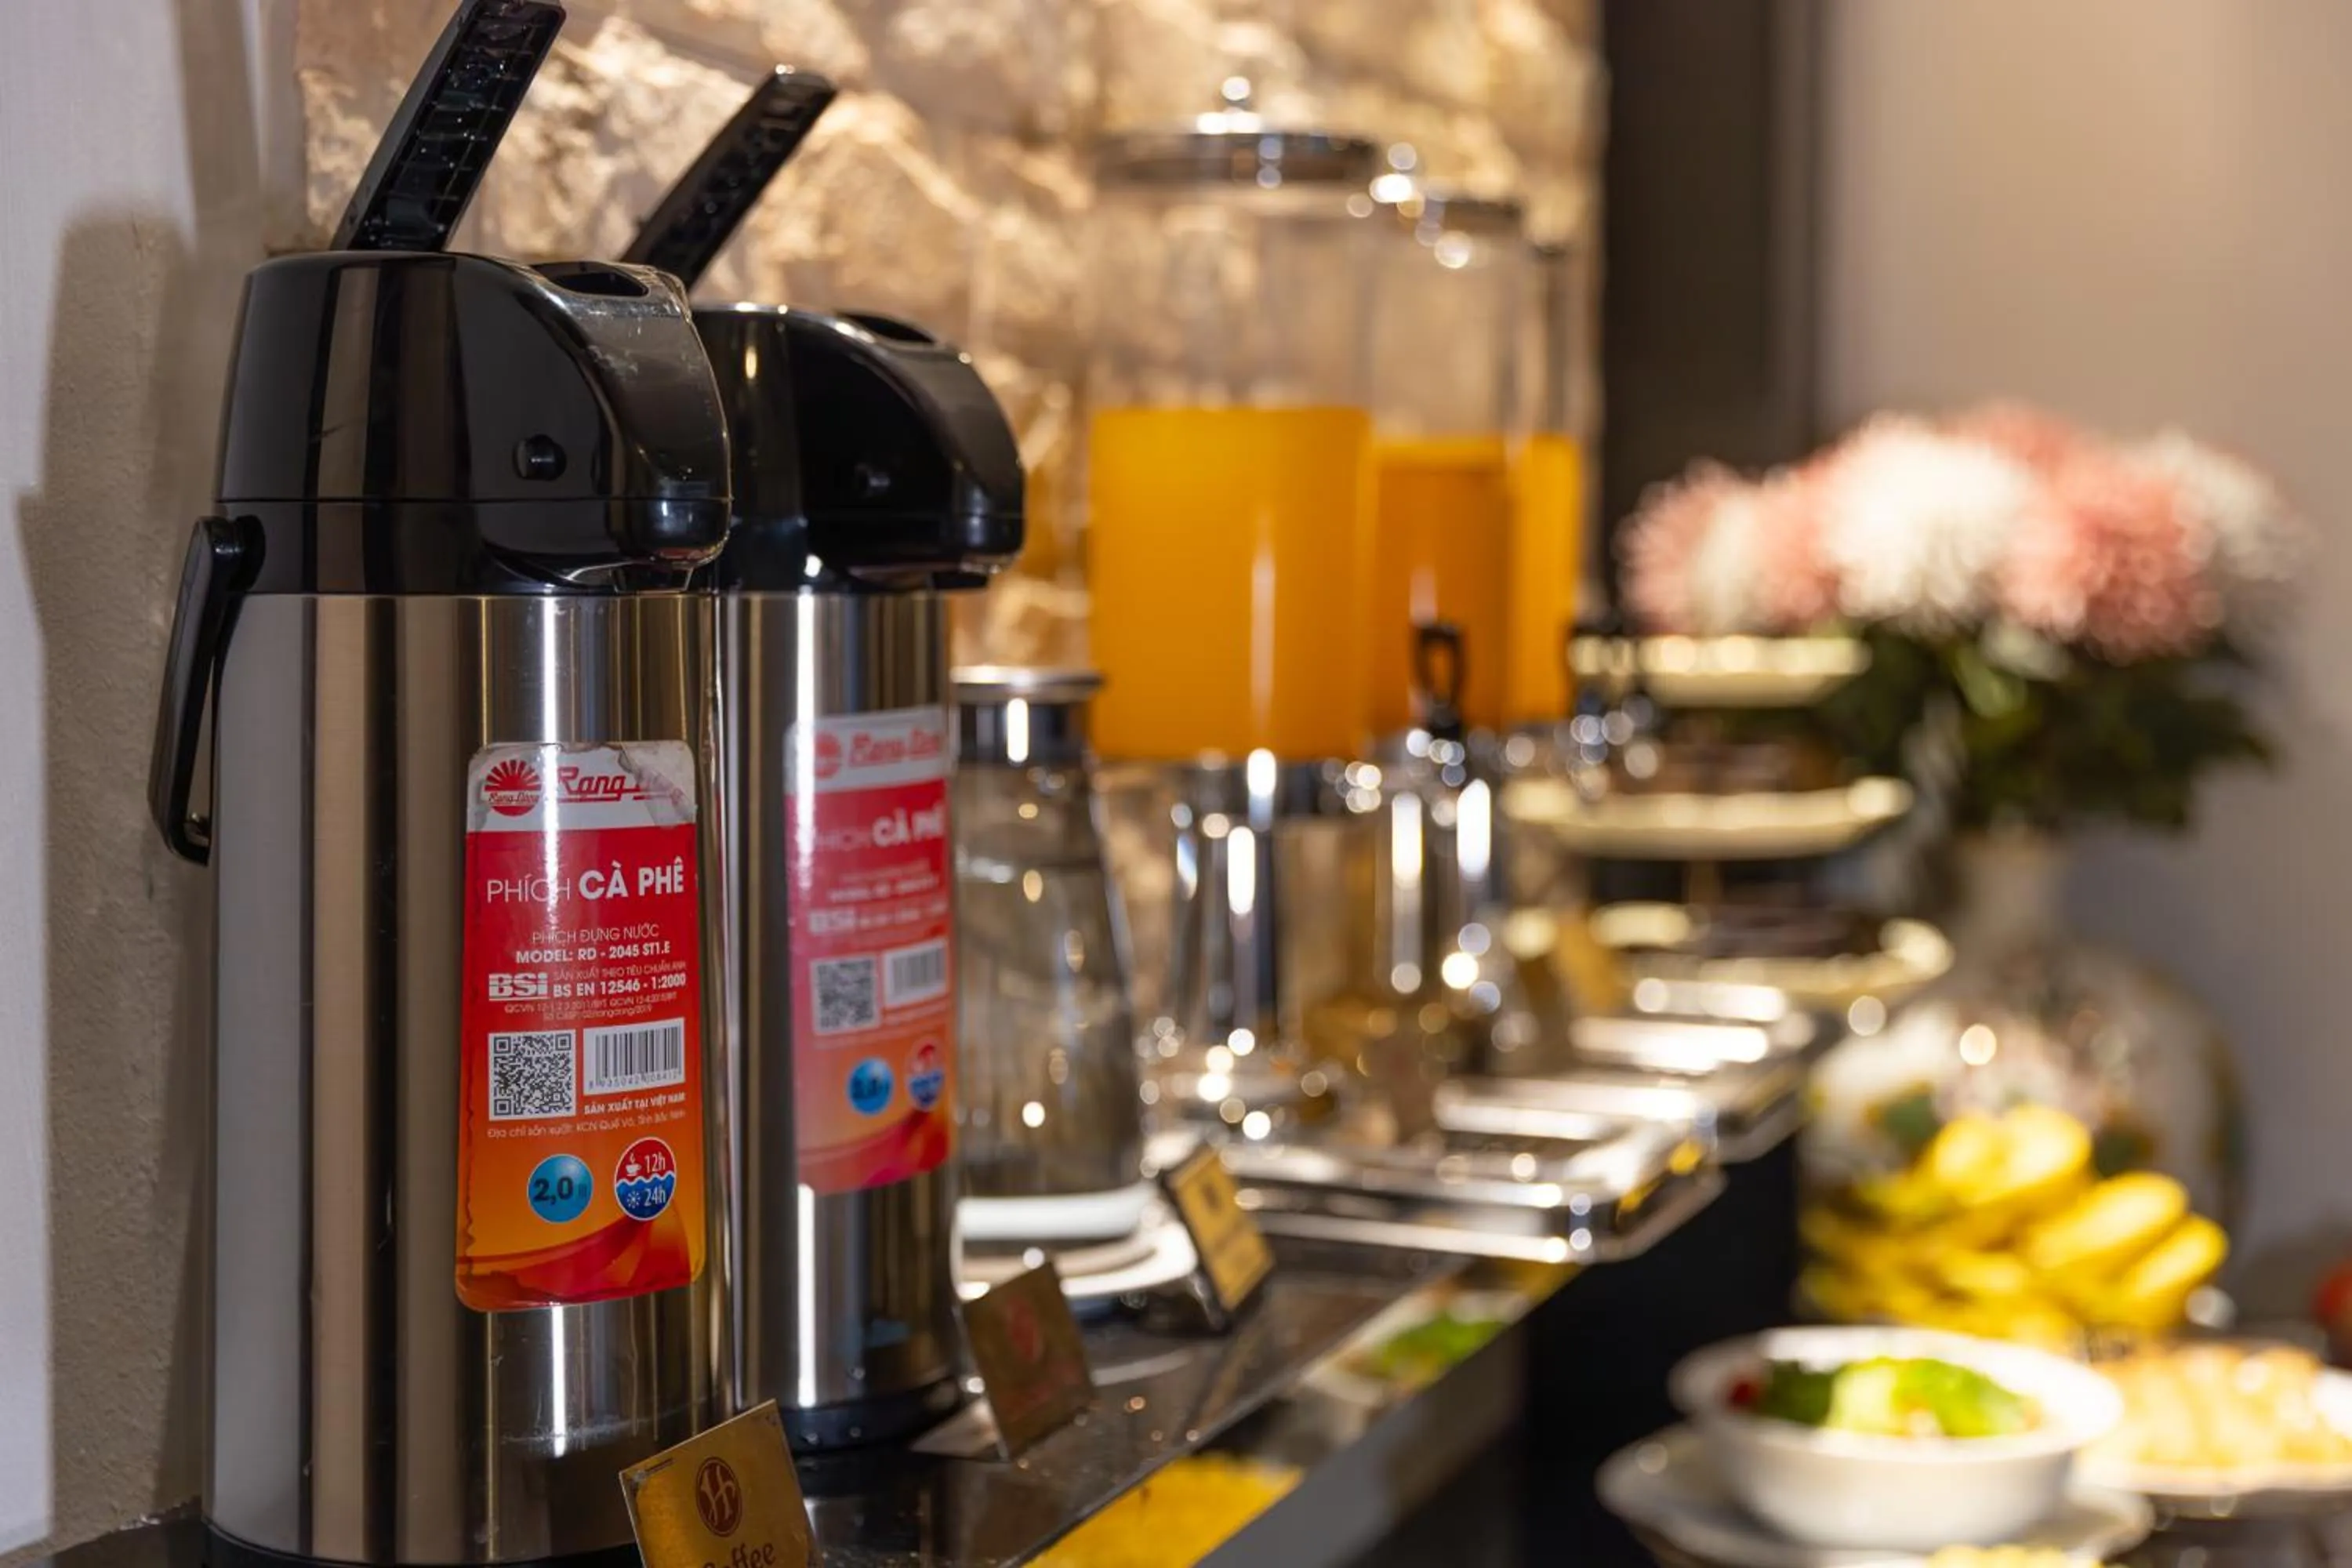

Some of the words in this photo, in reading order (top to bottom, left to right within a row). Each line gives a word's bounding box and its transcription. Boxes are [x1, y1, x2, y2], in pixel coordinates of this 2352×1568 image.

[487, 873, 571, 903] PHÍCH
[579, 859, 629, 900] CÀ
[637, 855, 684, 896] PHÊ
[516, 949, 574, 964] MODEL:
[578, 947, 597, 960] RD
[553, 983, 572, 998] BS
[576, 982, 596, 996] EN
[644, 1151, 666, 1174] 12h
[533, 1175, 573, 1205] 2,0
[644, 1185, 666, 1207] 24h
[703, 1541, 777, 1568] ffee
